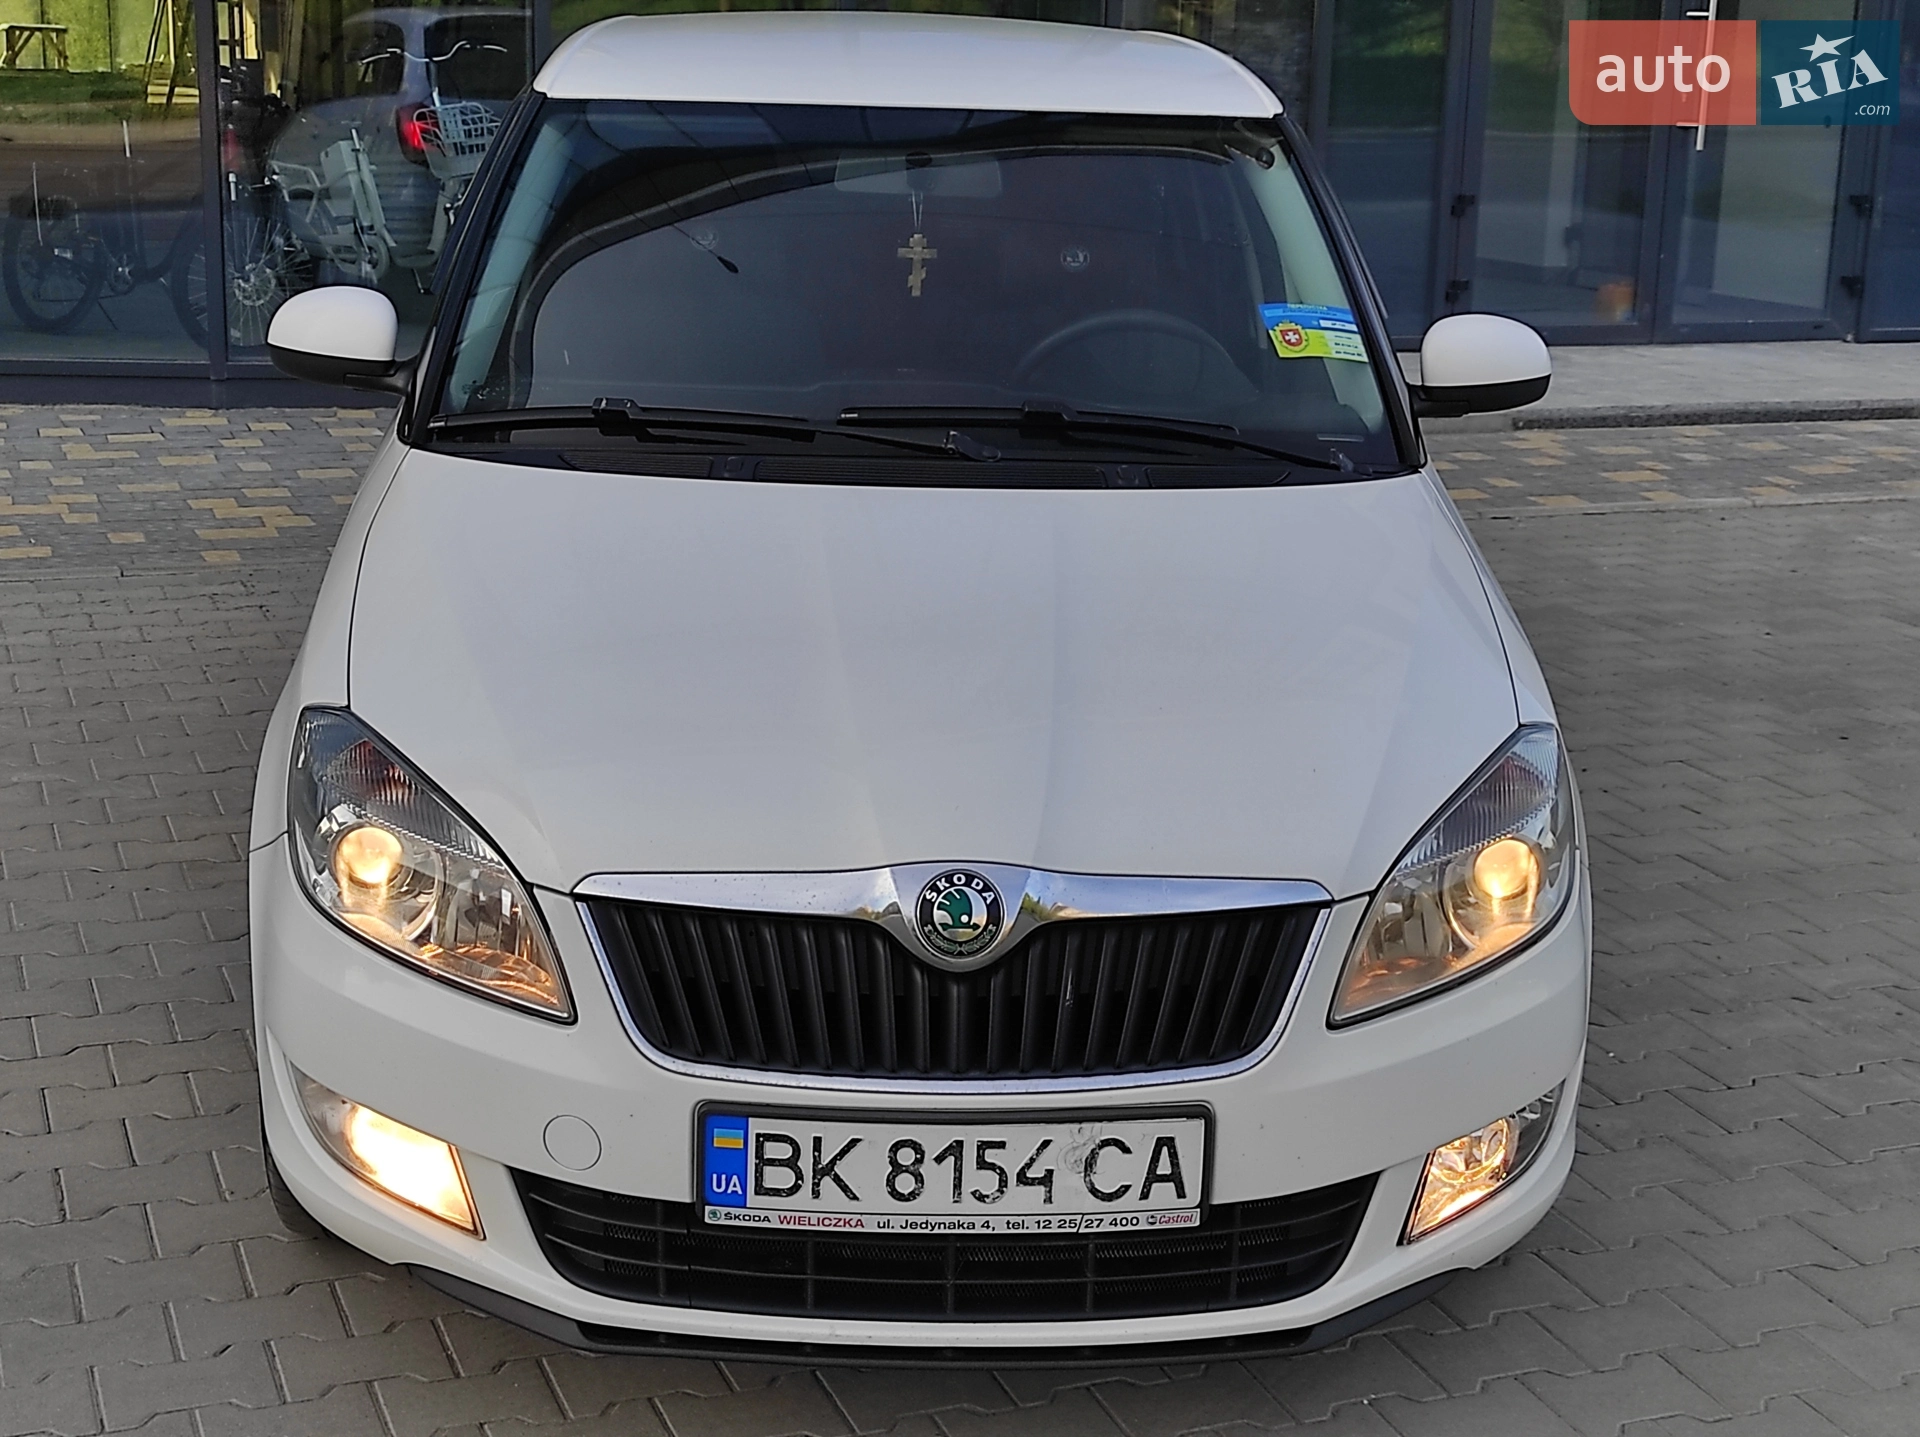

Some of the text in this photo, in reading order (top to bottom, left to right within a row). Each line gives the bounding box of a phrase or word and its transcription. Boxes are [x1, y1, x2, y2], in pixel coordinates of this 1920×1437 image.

[754, 1132, 1187, 1203] BK 8154 CA
[712, 1174, 742, 1195] UA
[778, 1215, 865, 1229] WIELICZKA
[877, 1219, 895, 1229] ul.
[900, 1219, 976, 1231] Jedynaka
[981, 1220, 996, 1232] 4,
[1006, 1220, 1029, 1230] tel.
[1035, 1219, 1052, 1229] 12
[1109, 1217, 1140, 1227] 400
[1158, 1213, 1194, 1225] Castrol
